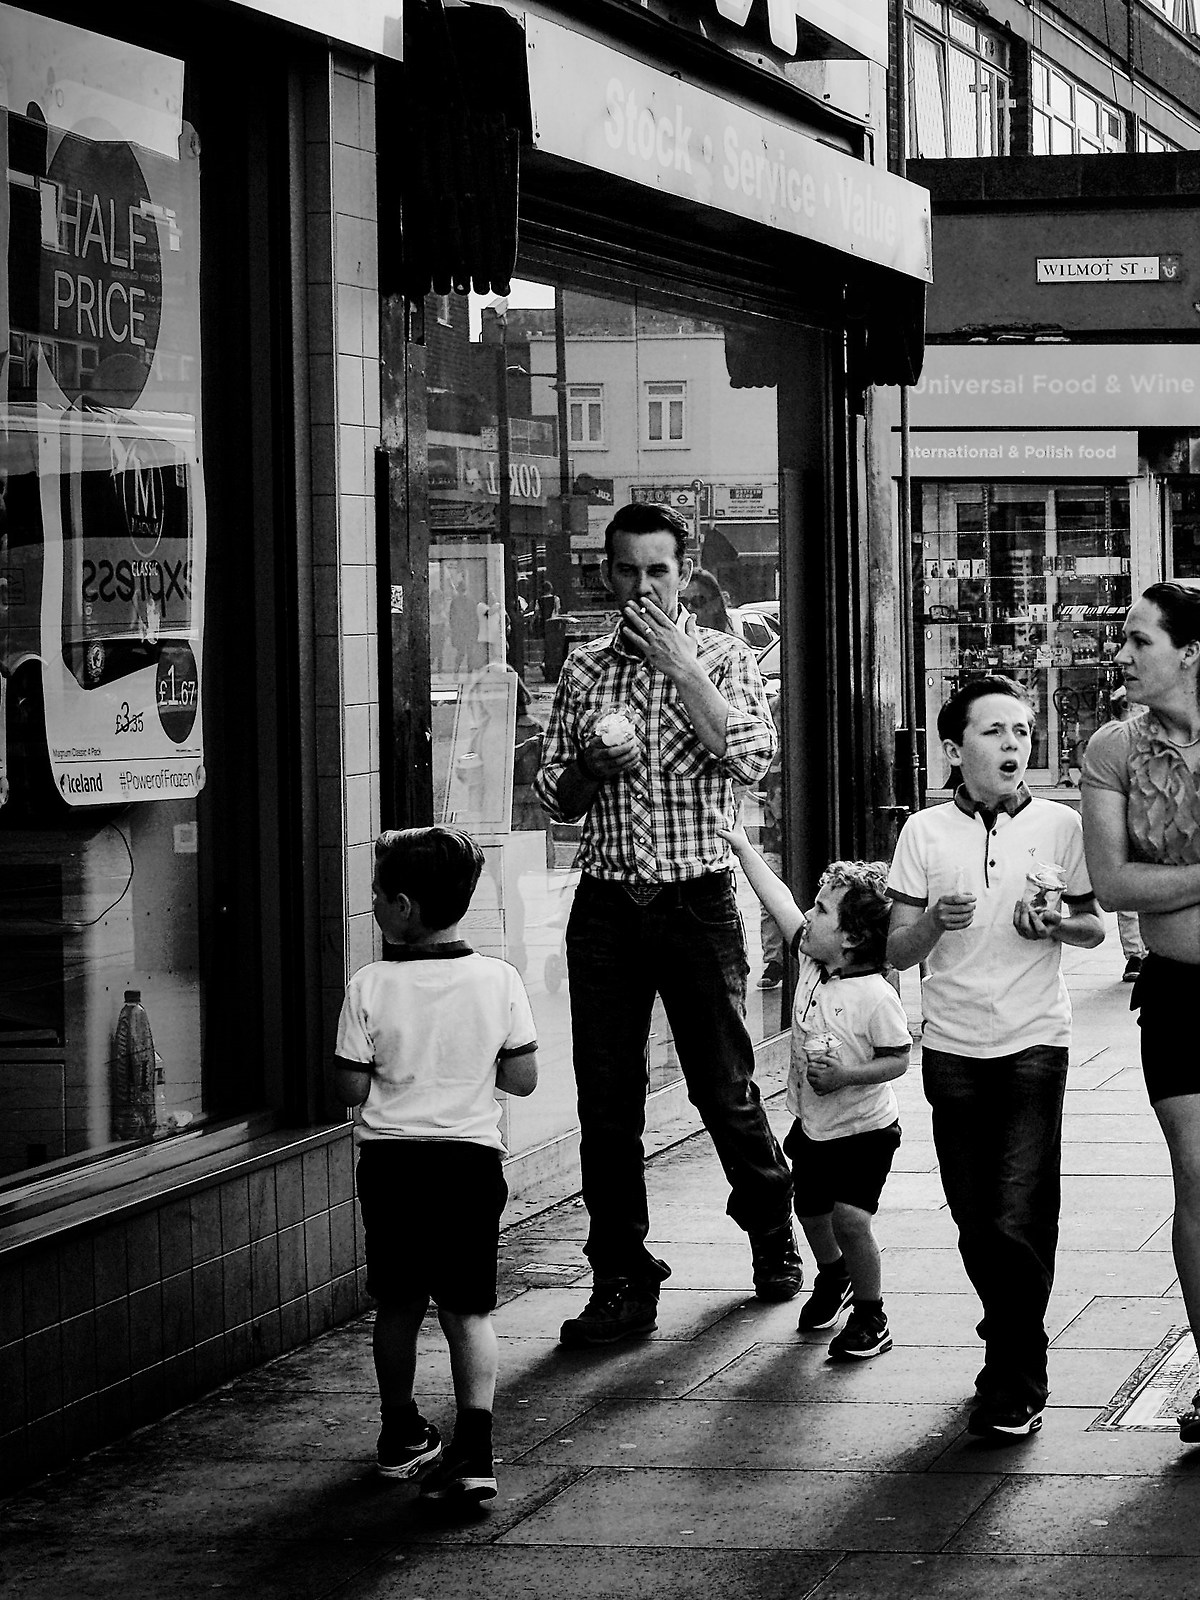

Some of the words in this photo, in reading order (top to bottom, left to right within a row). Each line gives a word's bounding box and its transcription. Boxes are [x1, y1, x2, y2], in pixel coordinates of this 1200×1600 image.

[604, 77, 693, 175] Stock
[723, 126, 817, 218] Service
[837, 174, 897, 246] Value
[55, 188, 147, 270] HALF
[1043, 263, 1113, 276] WILMOT
[1120, 262, 1139, 275] ST
[53, 269, 146, 347] PRICE
[911, 374, 1024, 395] Universal
[1032, 374, 1098, 395] Food
[1105, 374, 1122, 394] &
[1130, 373, 1195, 394] Wine
[905, 445, 1003, 460] nternational
[1008, 445, 1020, 459] &
[1024, 444, 1073, 460] Polish
[1078, 444, 1117, 459] food
[131, 561, 159, 577] CLASSIC
[159, 664, 196, 706] £1.67
[115, 702, 144, 735] £3.35
[119, 769, 194, 790] #PowerofFrozen
